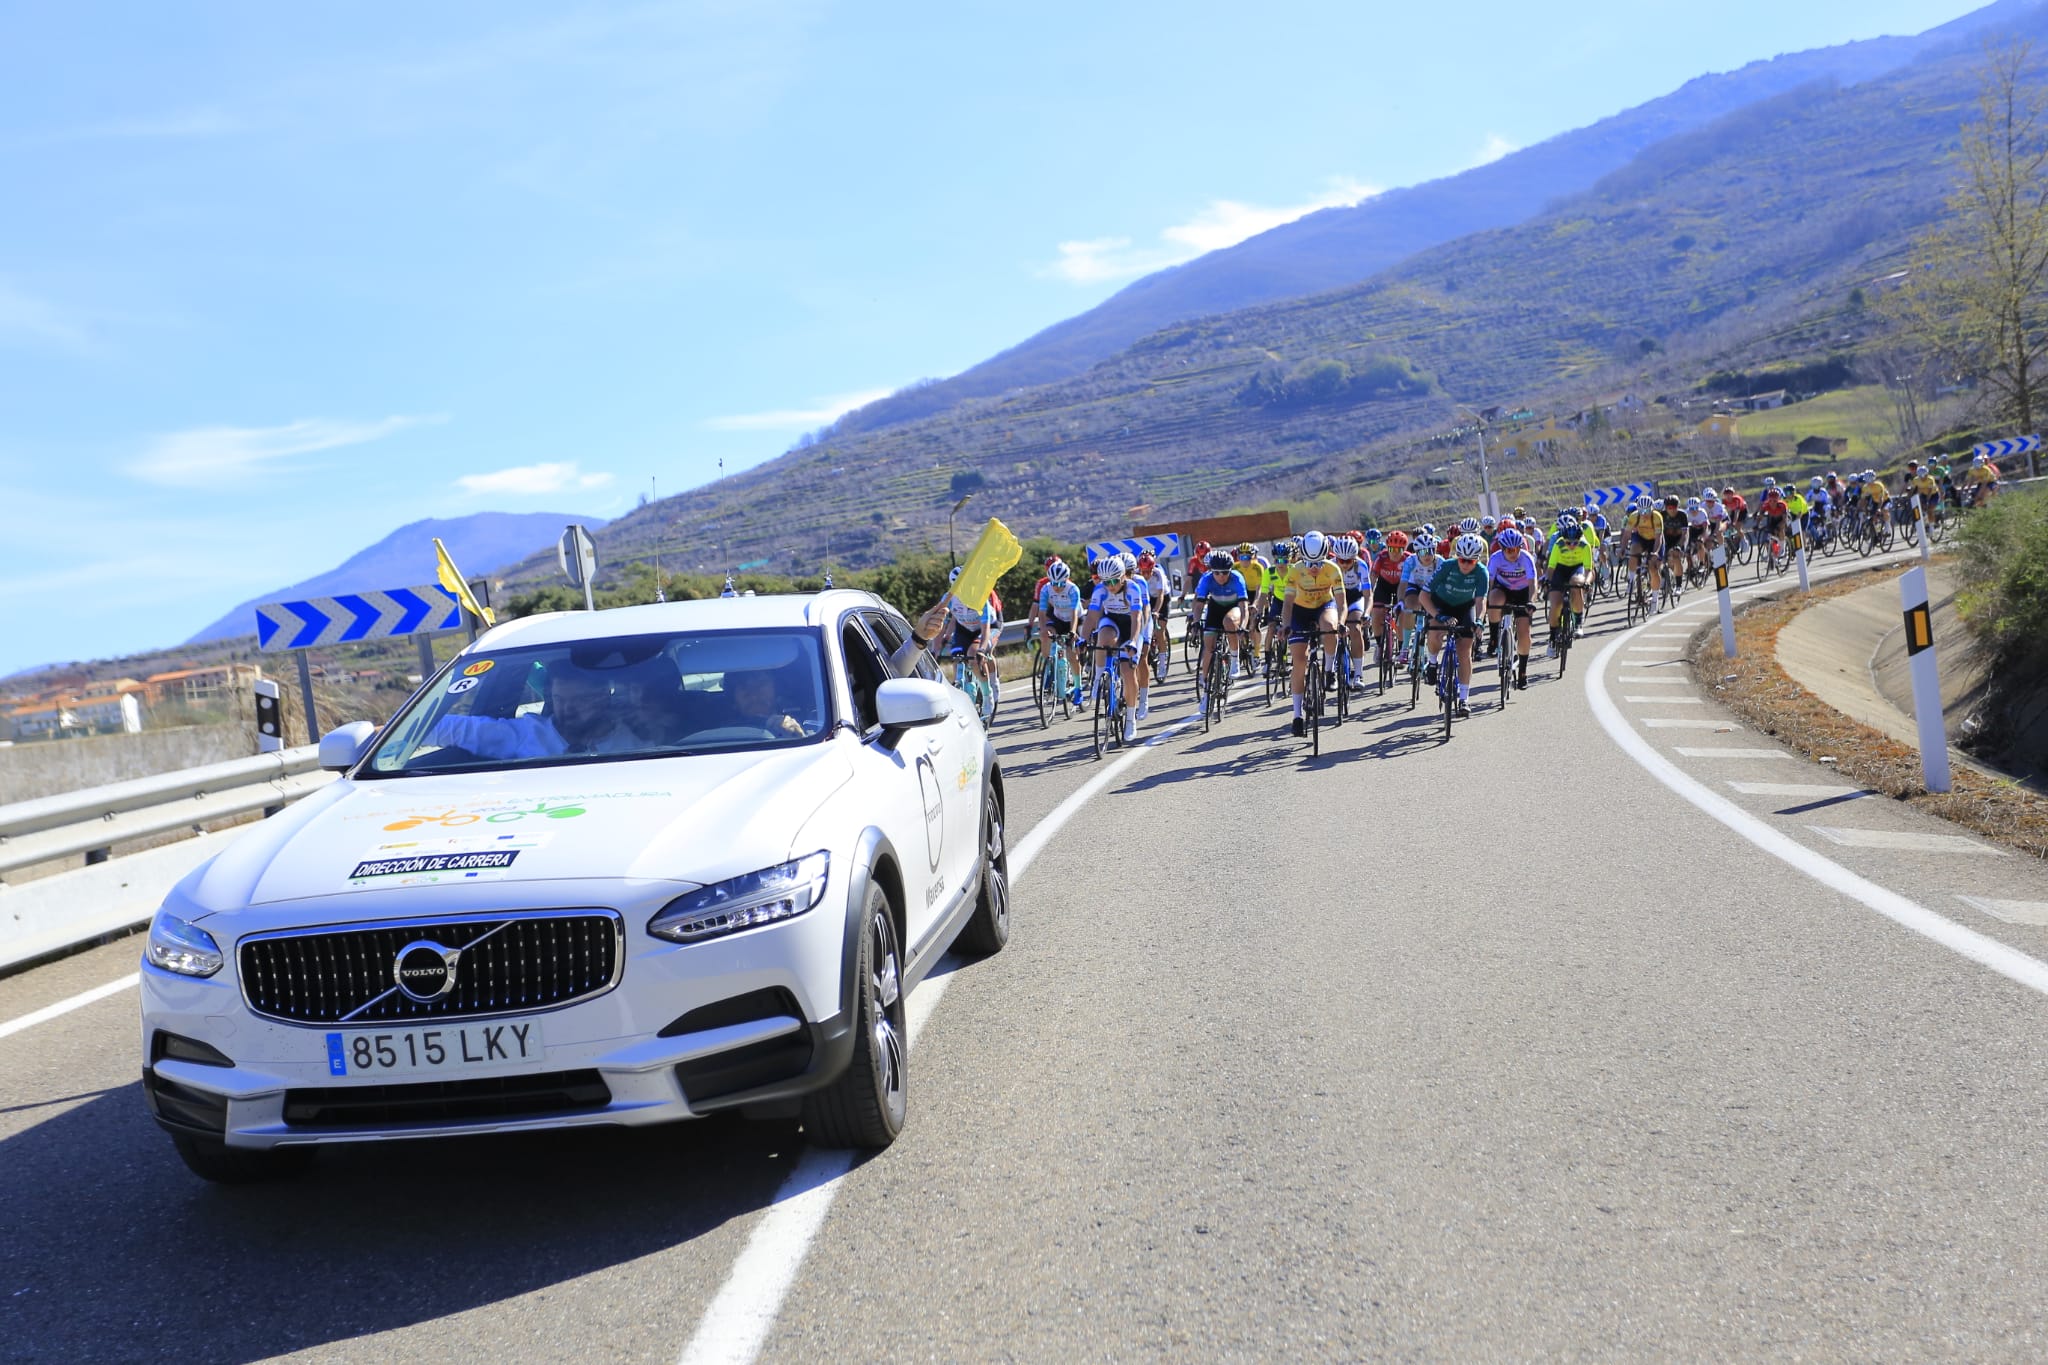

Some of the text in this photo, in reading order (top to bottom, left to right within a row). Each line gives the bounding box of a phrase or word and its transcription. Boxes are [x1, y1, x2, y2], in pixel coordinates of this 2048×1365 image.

[466, 661, 492, 674] M
[454, 679, 472, 691] R
[354, 856, 429, 877] DIRECCIÓN
[426, 856, 447, 870] DE
[447, 853, 511, 869] CARRERA
[401, 967, 445, 977] VOLVO
[352, 1023, 530, 1069] 8515 LKY
[334, 1058, 342, 1069] E
